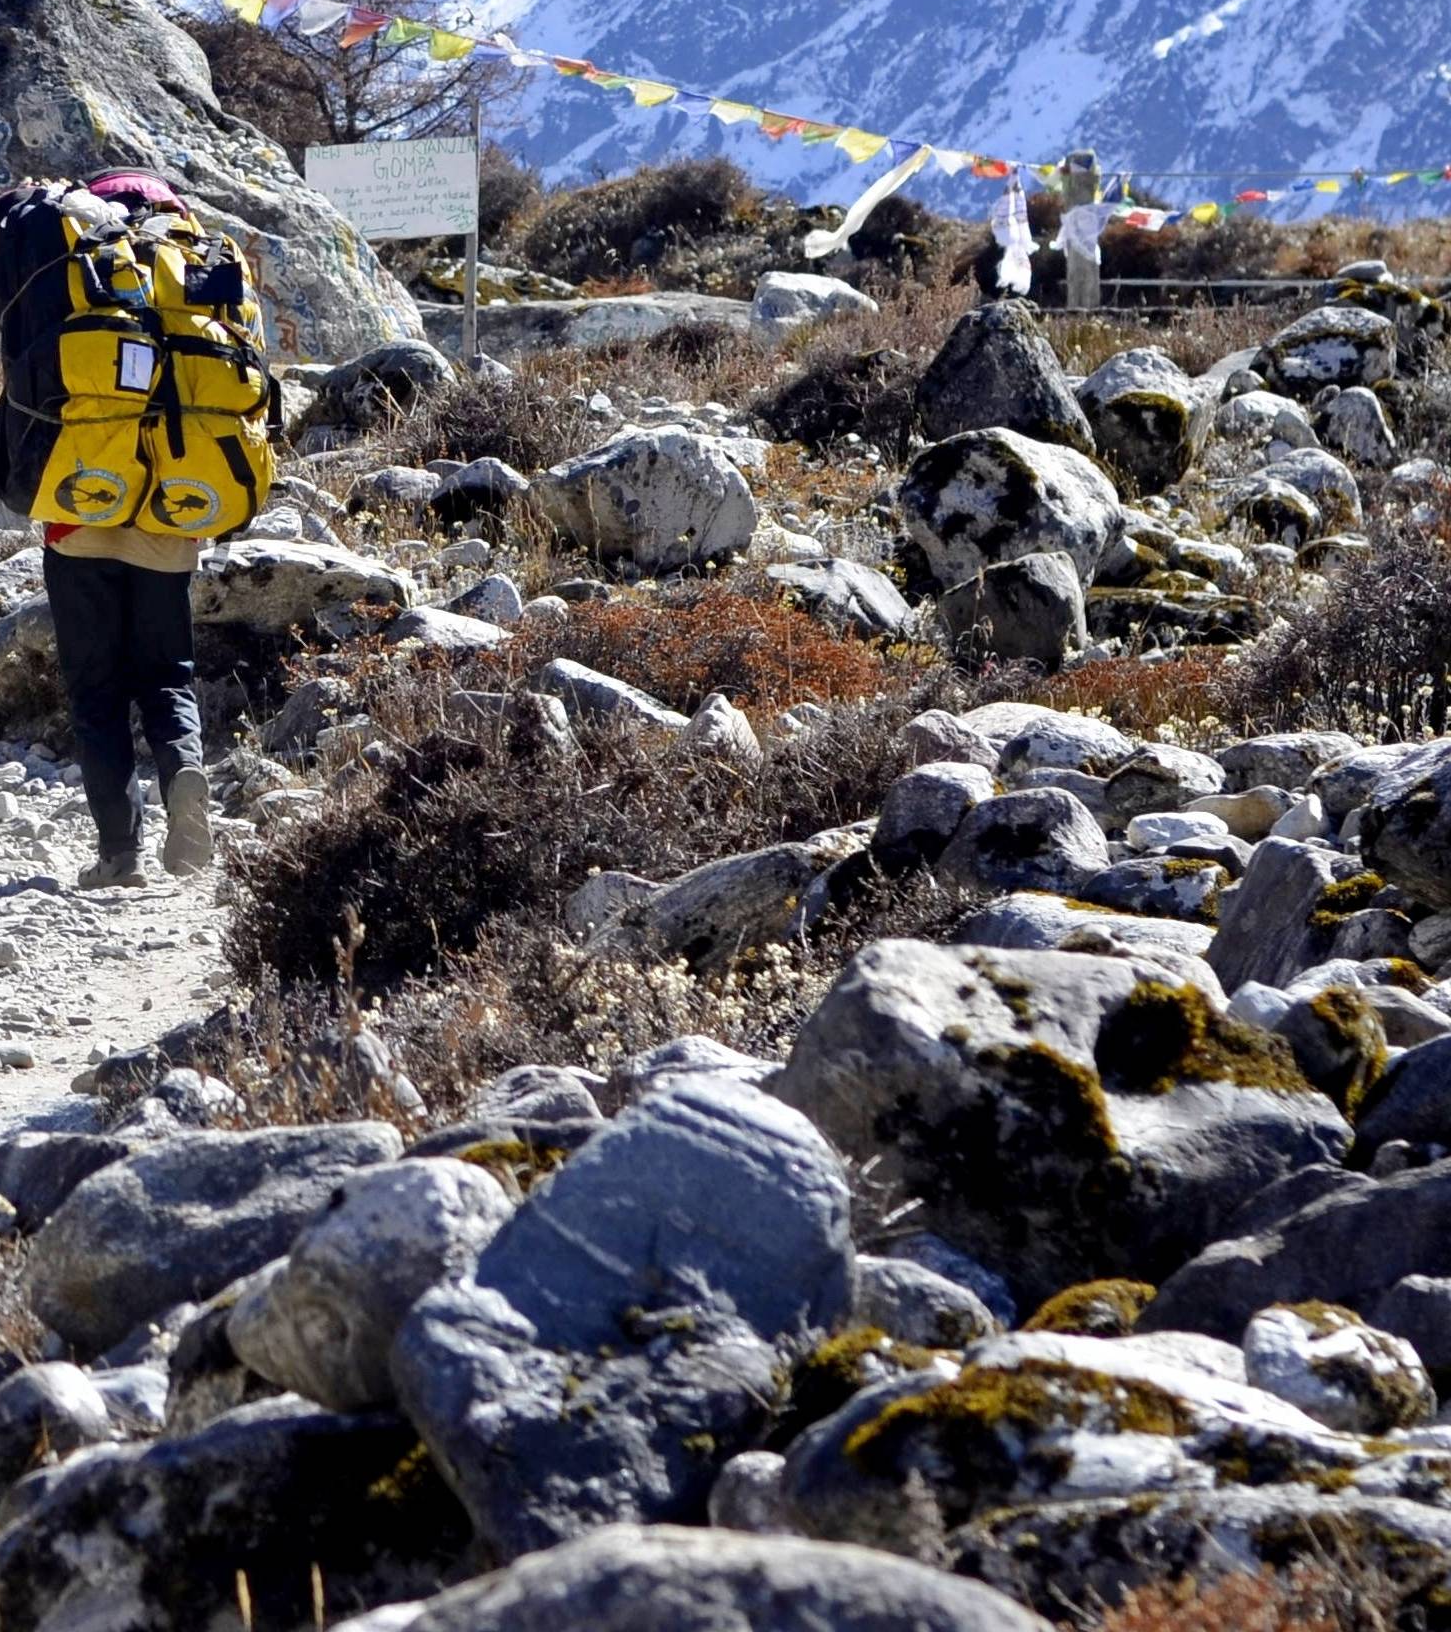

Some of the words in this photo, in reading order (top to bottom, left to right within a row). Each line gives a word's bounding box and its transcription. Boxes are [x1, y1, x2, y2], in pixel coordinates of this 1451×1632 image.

[309, 146, 340, 161] NEW
[354, 143, 382, 156] WAY
[391, 142, 408, 155] TO
[412, 137, 476, 155] KYANJIN
[373, 156, 436, 180] GOMPA
